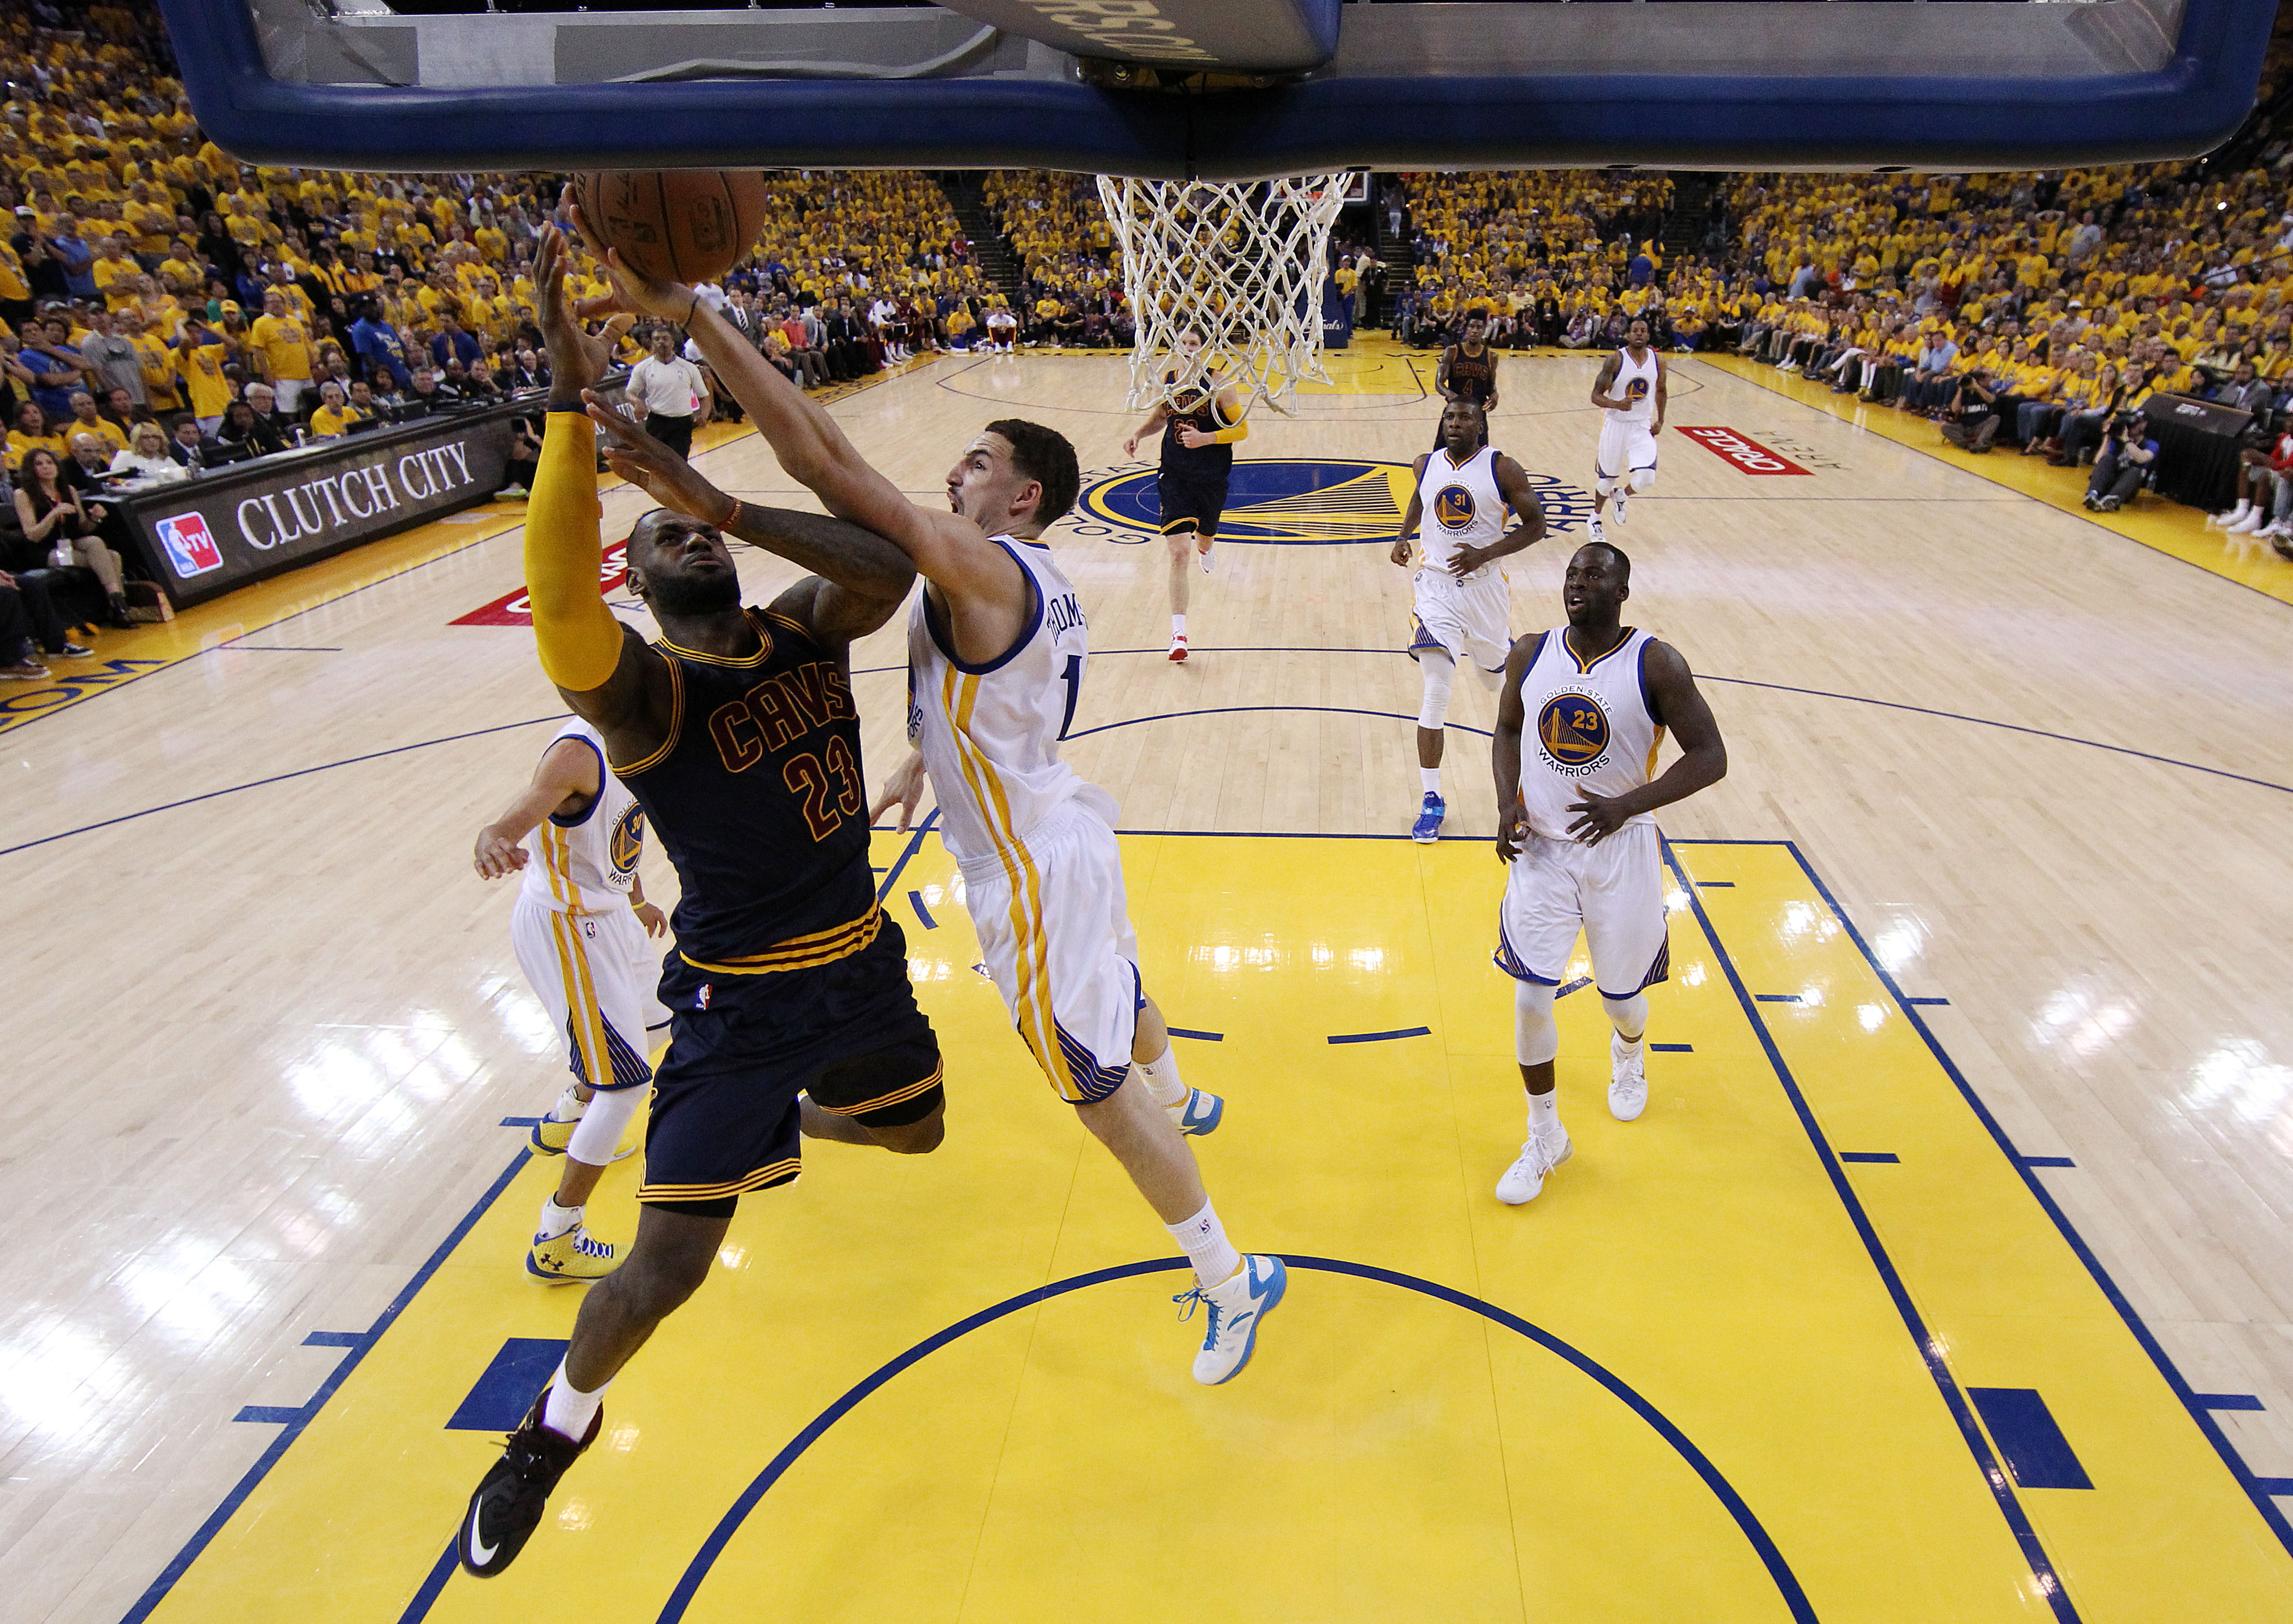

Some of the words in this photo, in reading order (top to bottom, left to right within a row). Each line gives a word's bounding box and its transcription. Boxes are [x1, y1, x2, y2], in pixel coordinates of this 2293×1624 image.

[1454, 361, 1489, 381] CAVS
[1462, 378, 1473, 396] 4
[1692, 429, 1786, 471] ORACLE
[237, 463, 400, 550] CLUTCH
[398, 441, 475, 500] CITY
[1434, 480, 1457, 495] GOLDEN
[1460, 481, 1475, 494] STATE
[1454, 494, 1466, 506] 31
[1437, 520, 1478, 537] WARRIORS
[186, 531, 209, 552] TV
[1540, 685, 1584, 705] GOLDEN
[1586, 689, 1613, 715] STATE
[708, 661, 857, 773] CAVS
[1572, 709, 1598, 731] 23
[1539, 747, 1610, 778] WARRIORS
[783, 735, 861, 842] 23
[631, 813, 643, 834] 30
